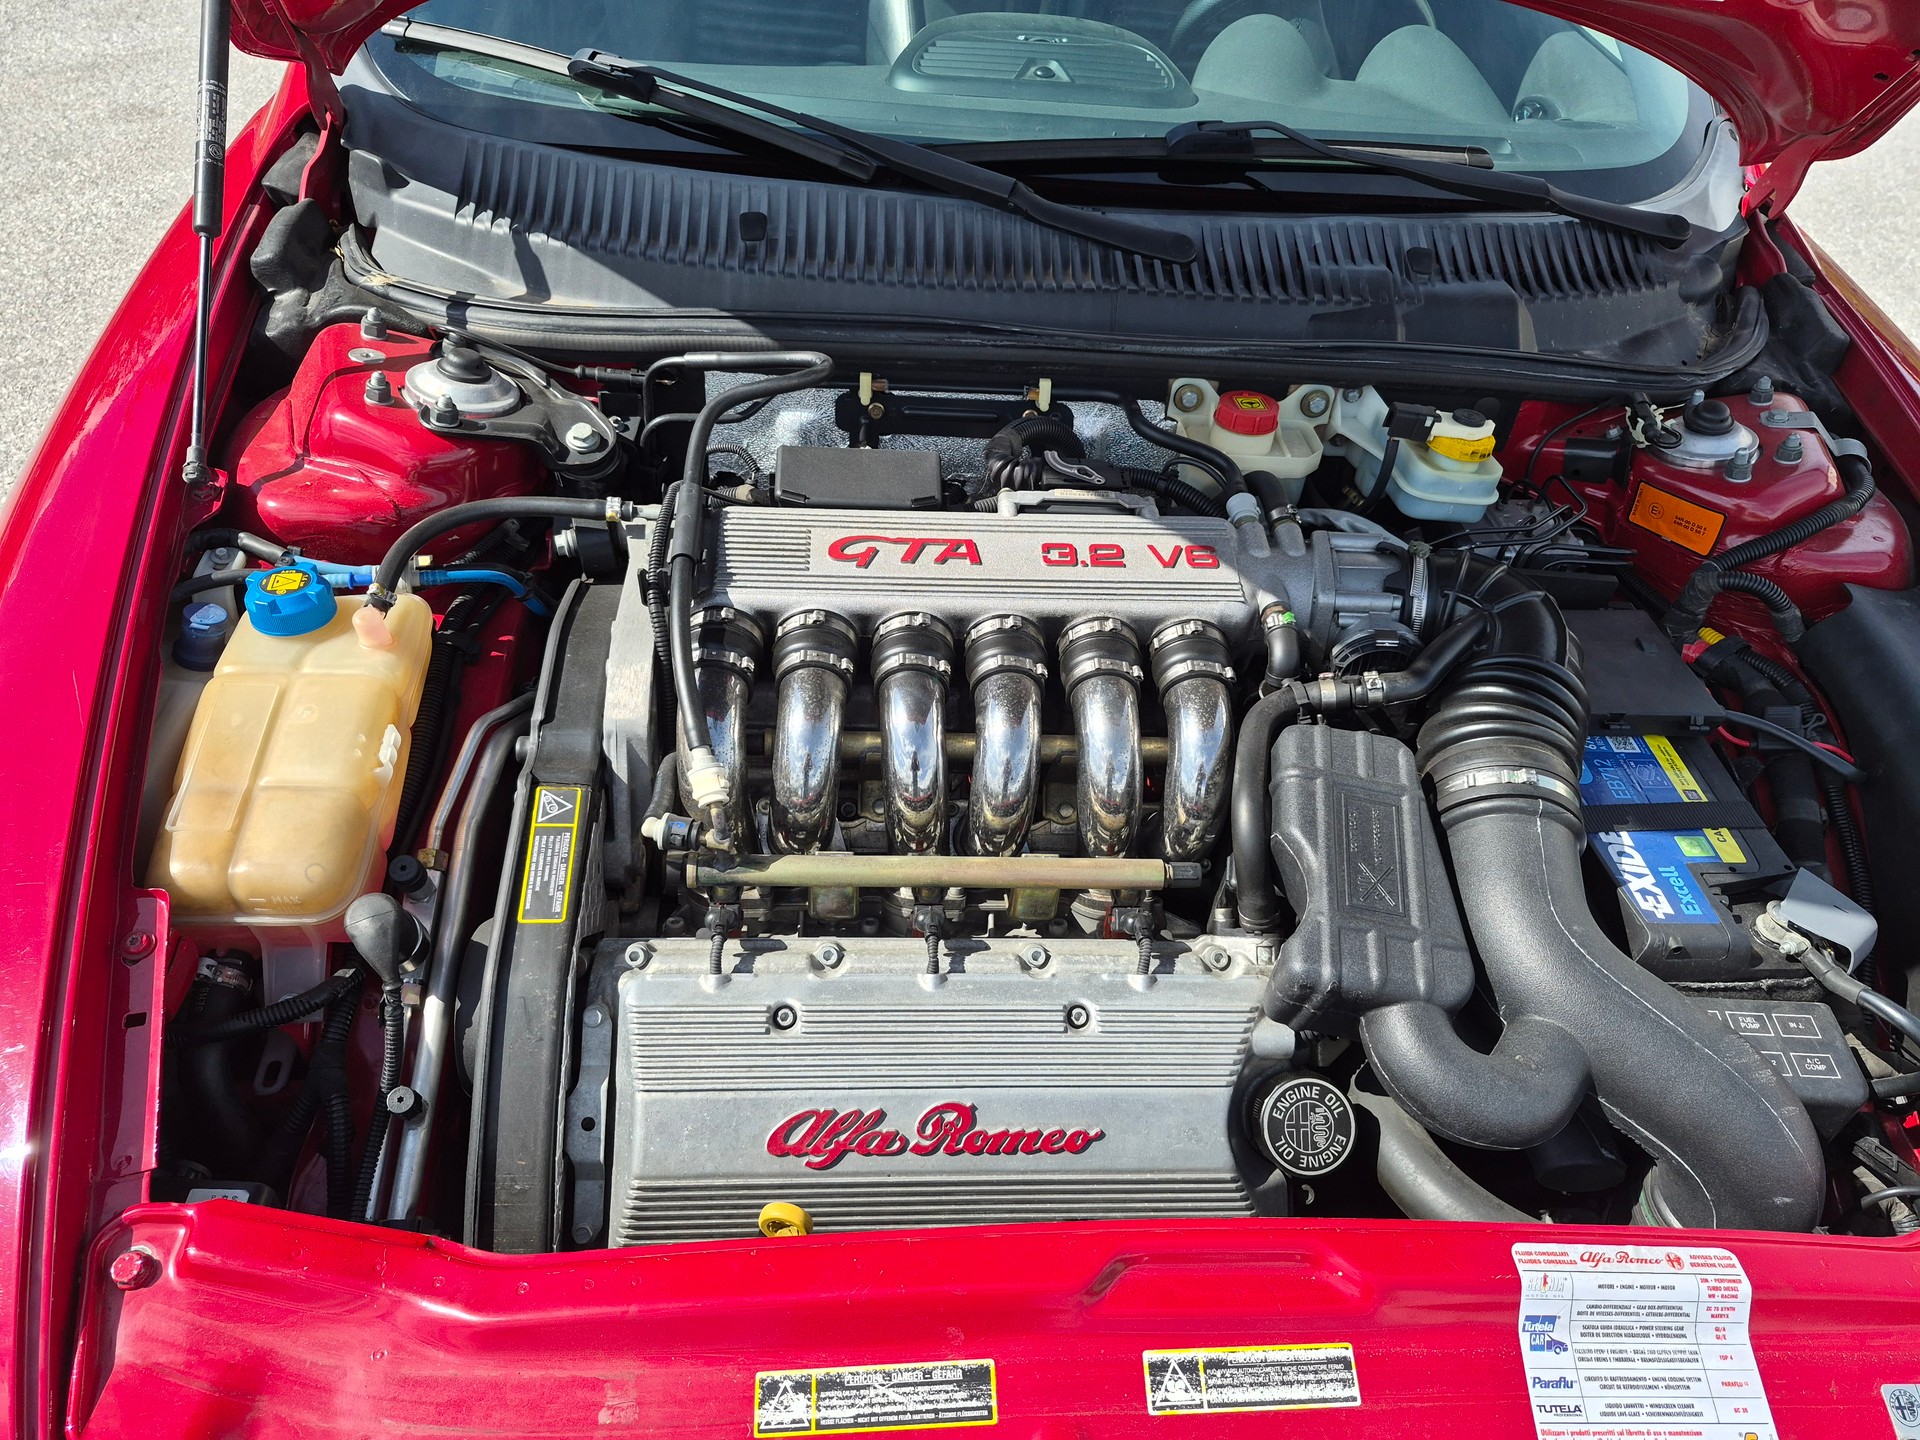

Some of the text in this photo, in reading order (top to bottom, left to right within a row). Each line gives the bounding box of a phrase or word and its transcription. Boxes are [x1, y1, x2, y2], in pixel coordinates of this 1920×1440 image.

[828, 535, 1220, 569] GTA 3.2 V6
[1594, 759, 1632, 798] EB712
[1709, 827, 1726, 843] CA
[557, 863, 566, 884] DANGER
[1658, 866, 1703, 915] Excell
[1273, 1086, 1344, 1119] ENGINE OIL
[766, 1101, 1105, 1170] Alfa Romeo
[1275, 1134, 1347, 1168] ENGINE OIL
[1580, 1251, 1615, 1268] Alfa
[1615, 1251, 1663, 1264] Romeo
[1523, 1321, 1554, 1332] Tutela
[1531, 1333, 1545, 1346] CAR
[932, 1369, 963, 1380] GEFAHR
[1532, 1376, 1573, 1389] Paraflu
[1536, 1405, 1582, 1413] TUTELA
